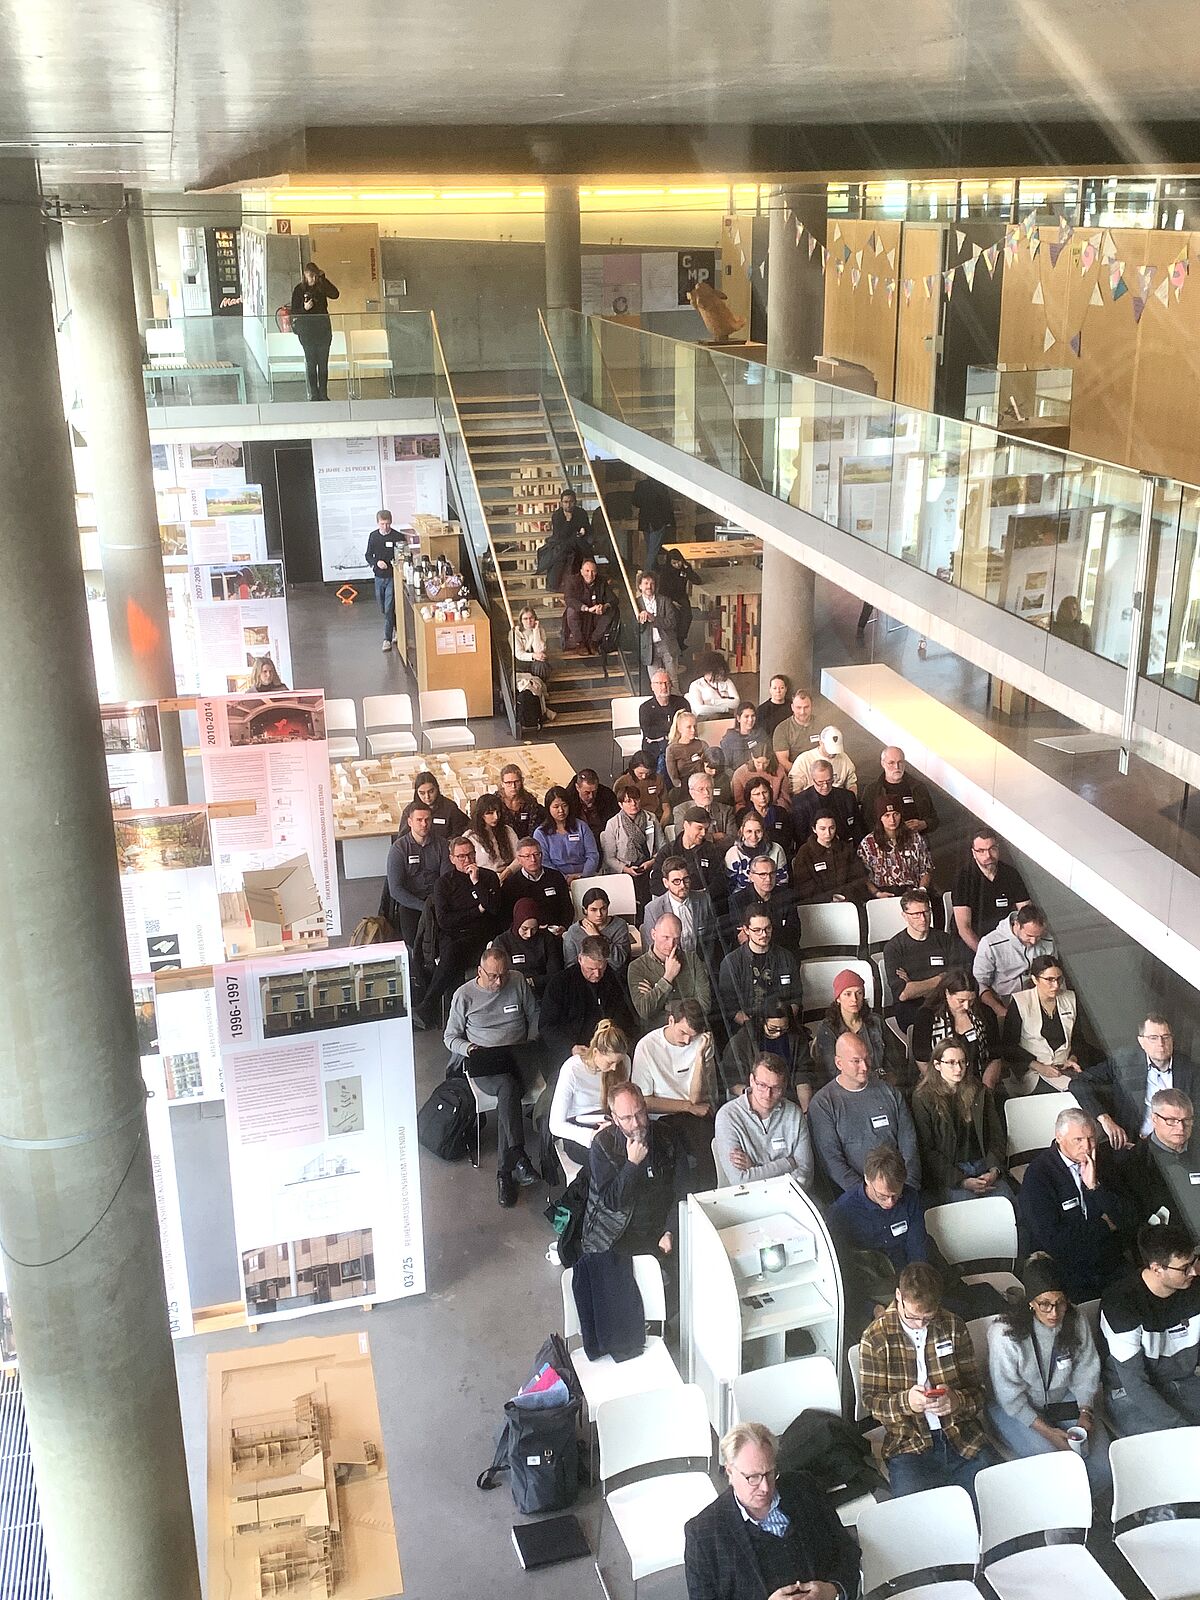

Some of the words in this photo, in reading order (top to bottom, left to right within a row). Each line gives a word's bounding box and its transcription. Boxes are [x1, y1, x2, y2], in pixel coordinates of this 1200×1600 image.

[194, 566, 203, 600] 2007-2008
[204, 702, 216, 745] 2010-2014
[325, 909, 334, 931] 17/25
[226, 976, 243, 1038] 1996-1997
[403, 1257, 414, 1288] 03/25
[168, 1301, 180, 1333] 04/25
